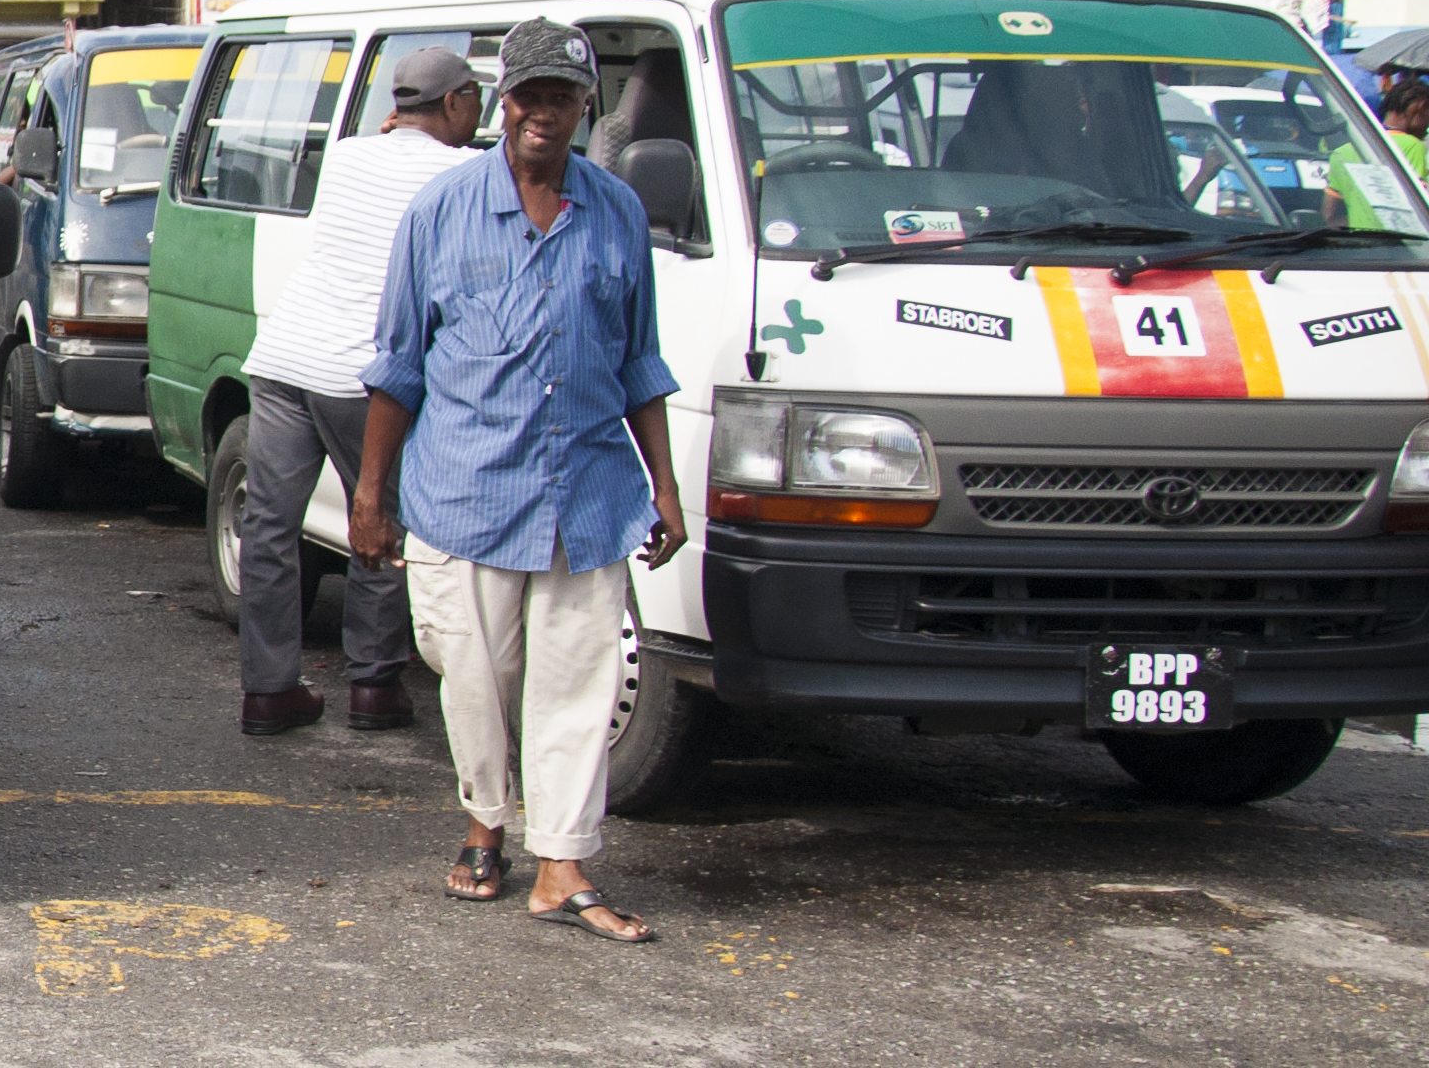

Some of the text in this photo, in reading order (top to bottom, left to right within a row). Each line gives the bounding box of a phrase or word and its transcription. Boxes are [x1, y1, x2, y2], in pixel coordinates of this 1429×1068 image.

[903, 303, 1006, 337] STABROEK
[1136, 306, 1189, 346] 41
[1309, 309, 1396, 341] SOUTH
[1128, 653, 1199, 685] BPP
[1111, 689, 1207, 723] 9893
